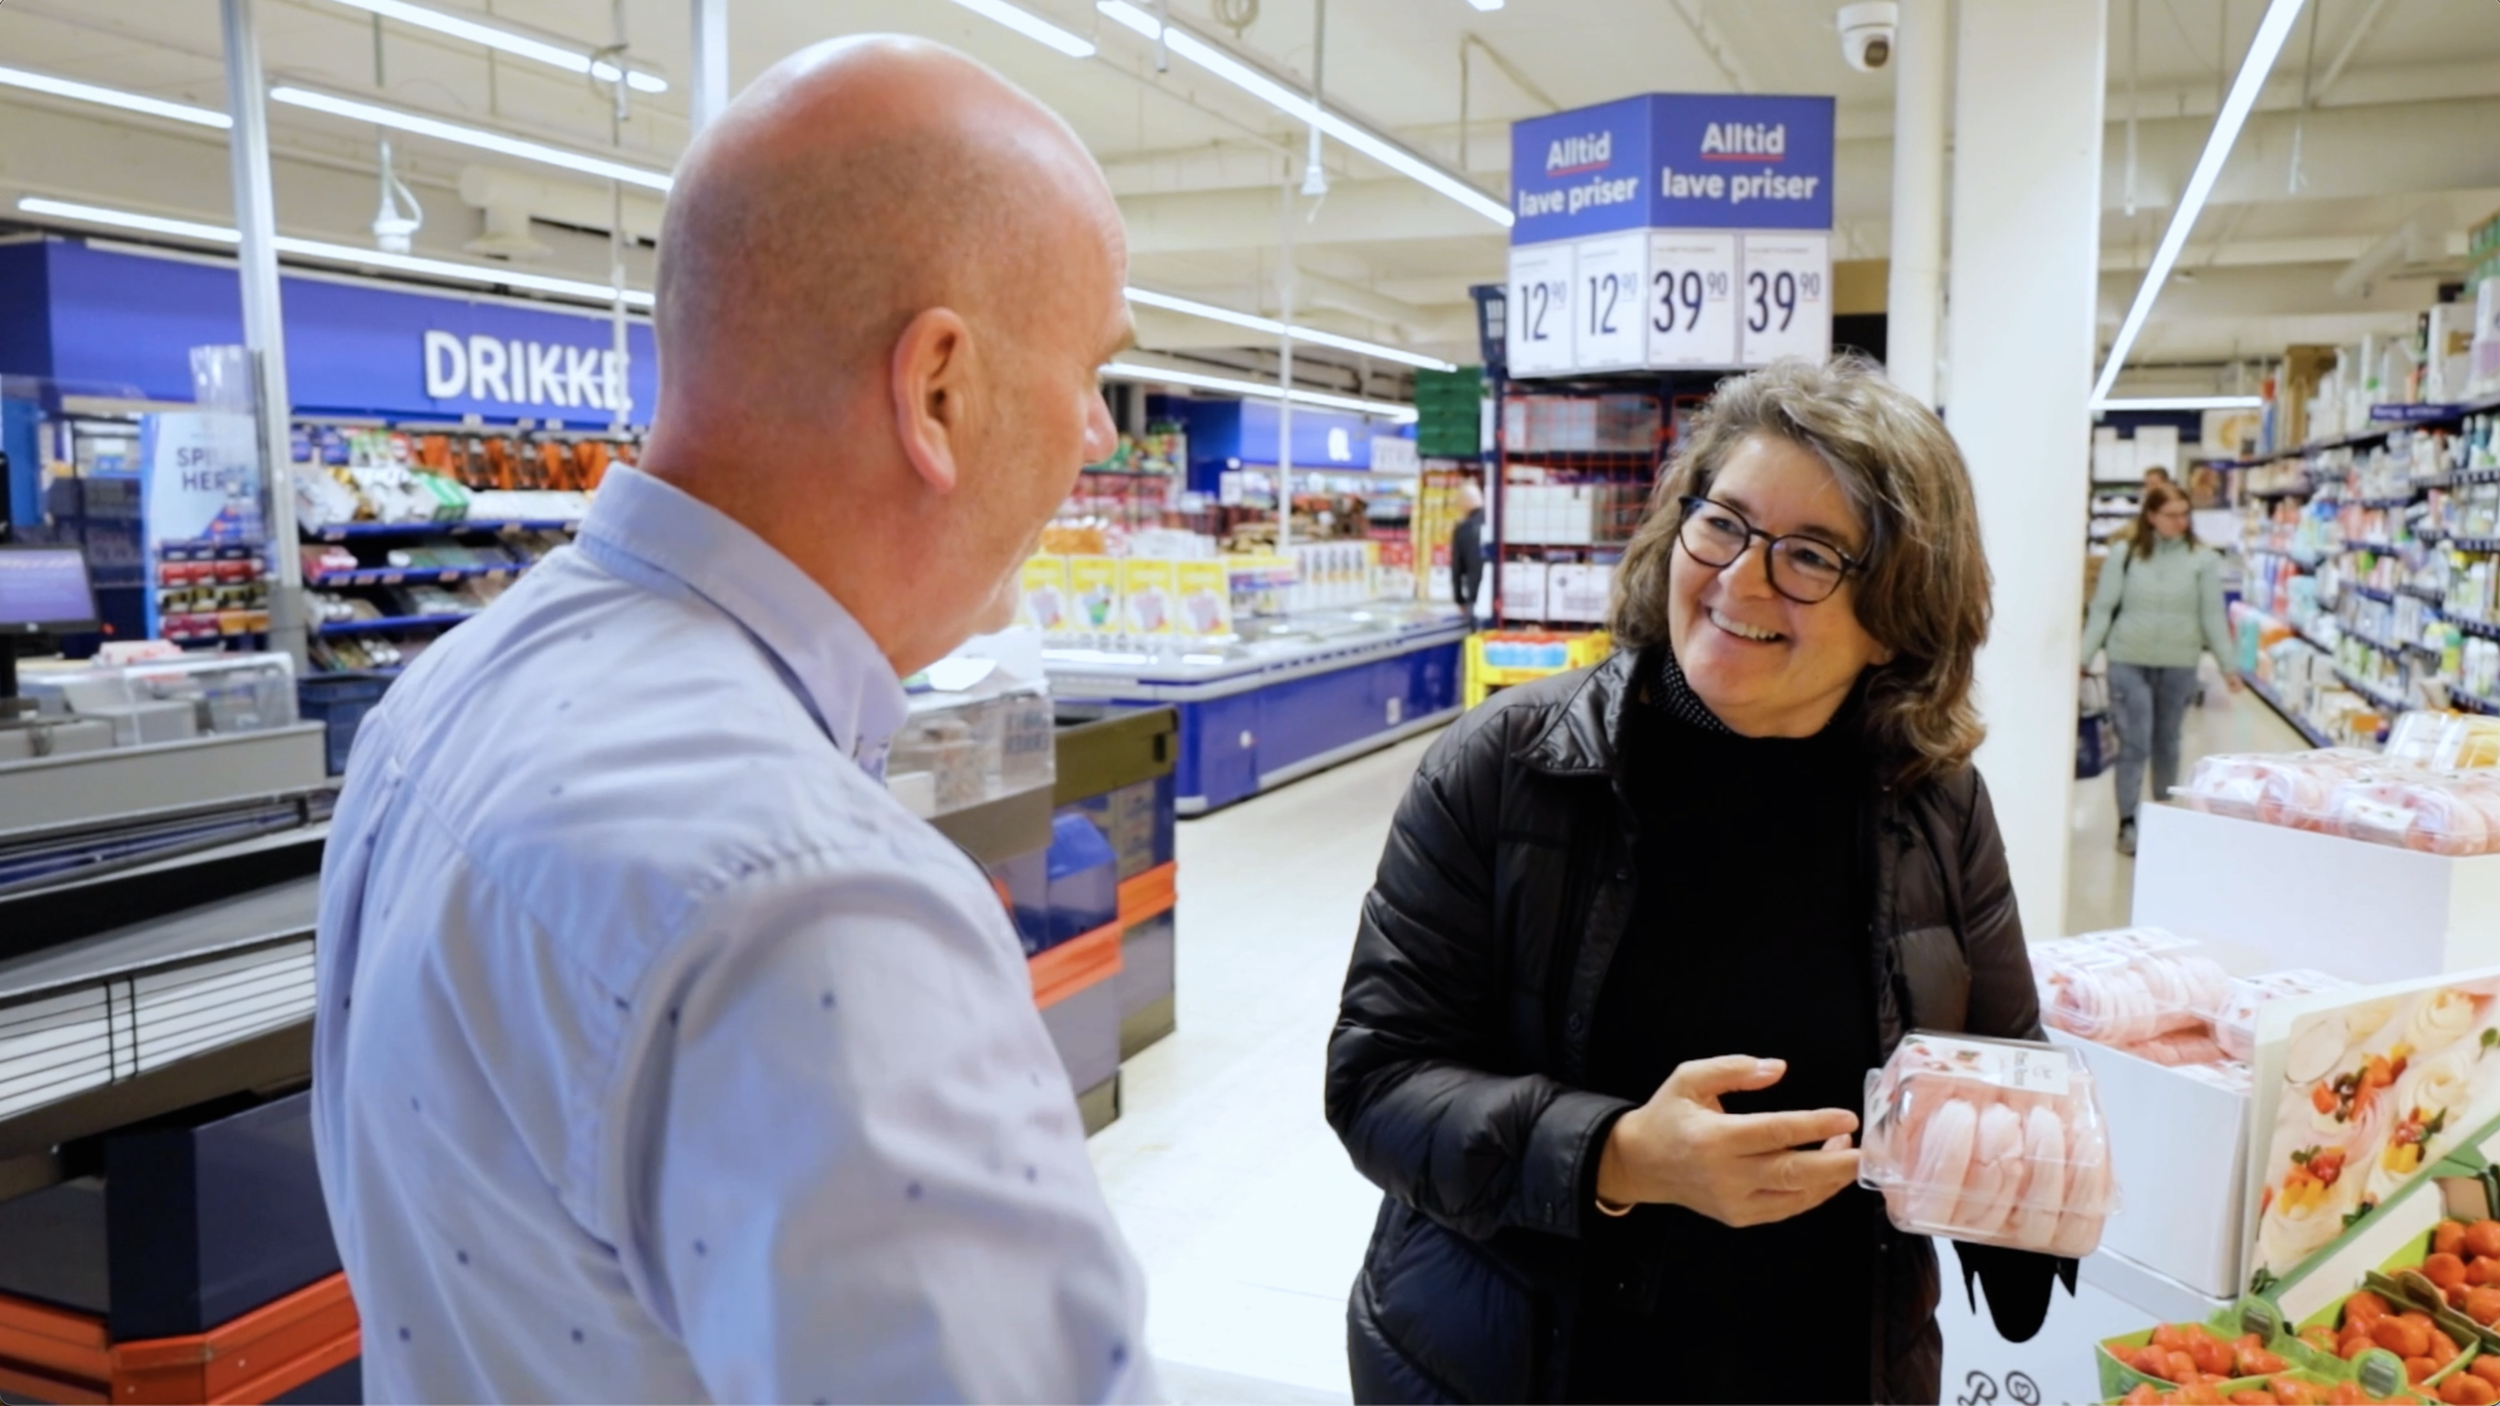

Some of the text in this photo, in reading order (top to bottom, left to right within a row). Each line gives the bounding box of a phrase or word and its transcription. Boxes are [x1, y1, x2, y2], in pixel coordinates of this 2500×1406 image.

[1546, 131, 1611, 170] Alltid
[1701, 123, 1785, 154] Alltid
[1518, 177, 1639, 218] lave priser
[1662, 167, 1819, 204] lave priser
[1521, 282, 1549, 341] 12
[1589, 273, 1618, 336] 12
[1653, 270, 1728, 332] 39 90
[1748, 271, 1820, 332] 39 90
[425, 330, 633, 411] DRIKKE
